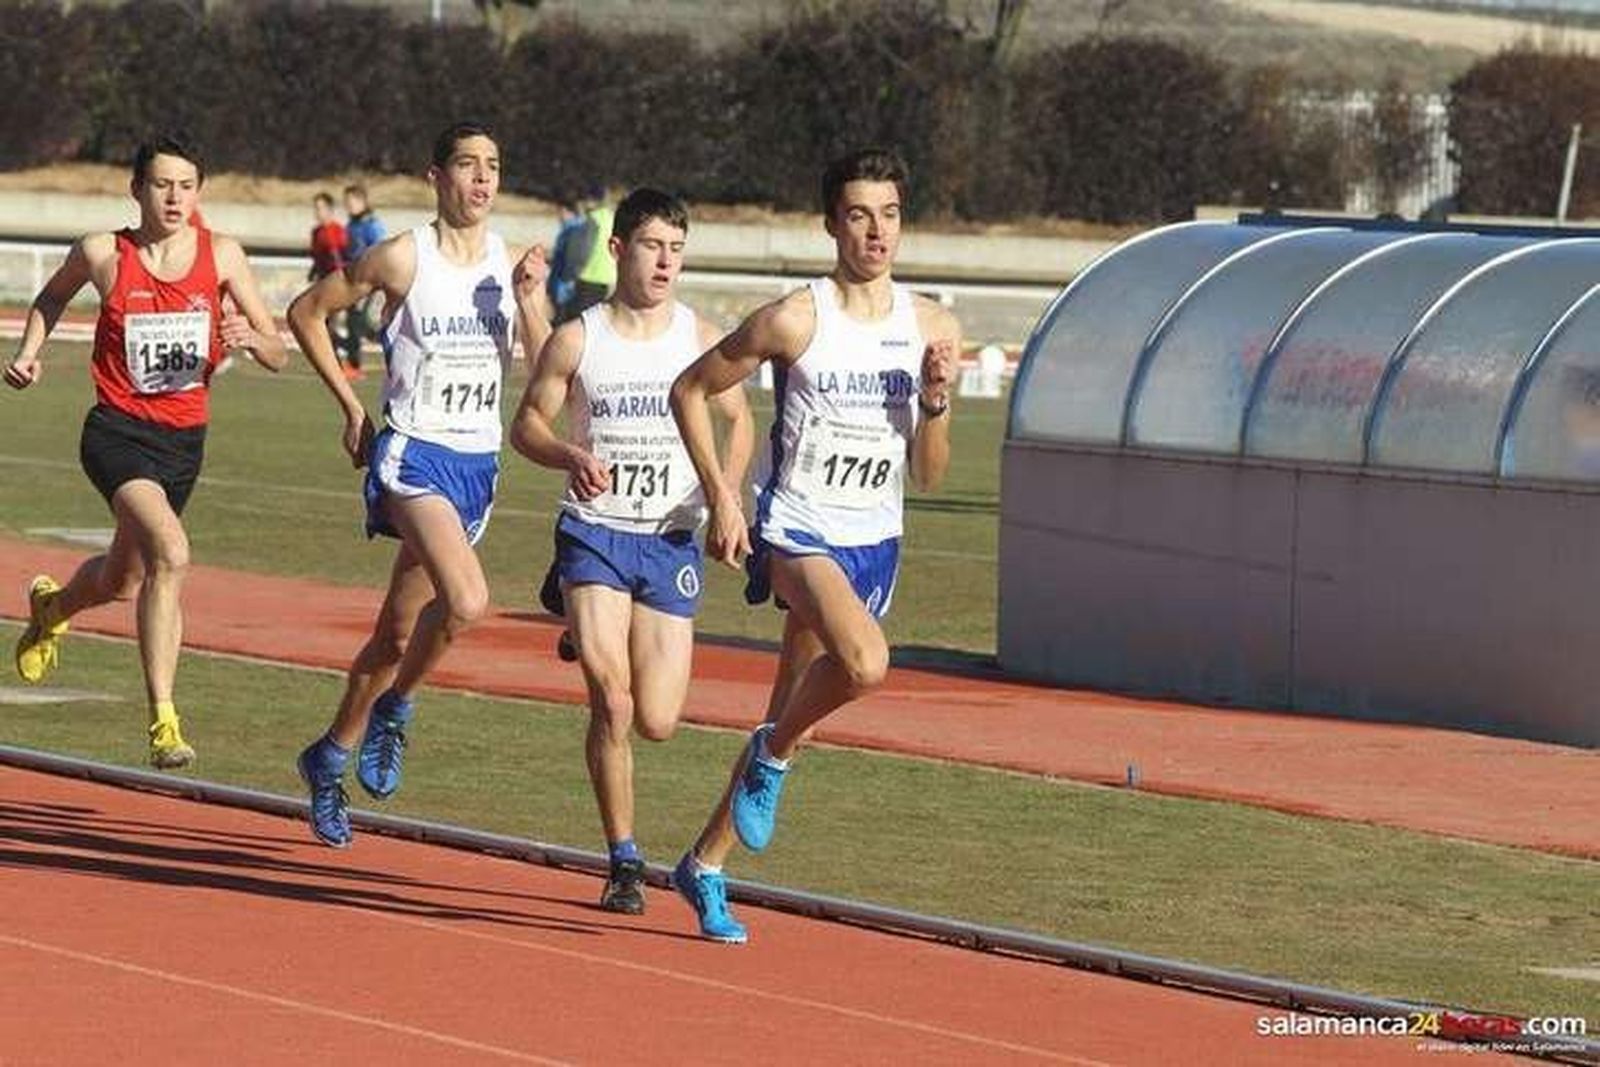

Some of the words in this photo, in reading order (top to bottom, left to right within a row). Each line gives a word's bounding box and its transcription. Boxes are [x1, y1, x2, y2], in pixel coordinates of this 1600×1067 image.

[421, 316, 441, 336] LA
[140, 342, 198, 374] 1583
[441, 380, 497, 413] 1714
[818, 372, 839, 393] LA
[617, 395, 670, 418] ARMU
[608, 463, 670, 498] 1731
[823, 453, 892, 490] 1718
